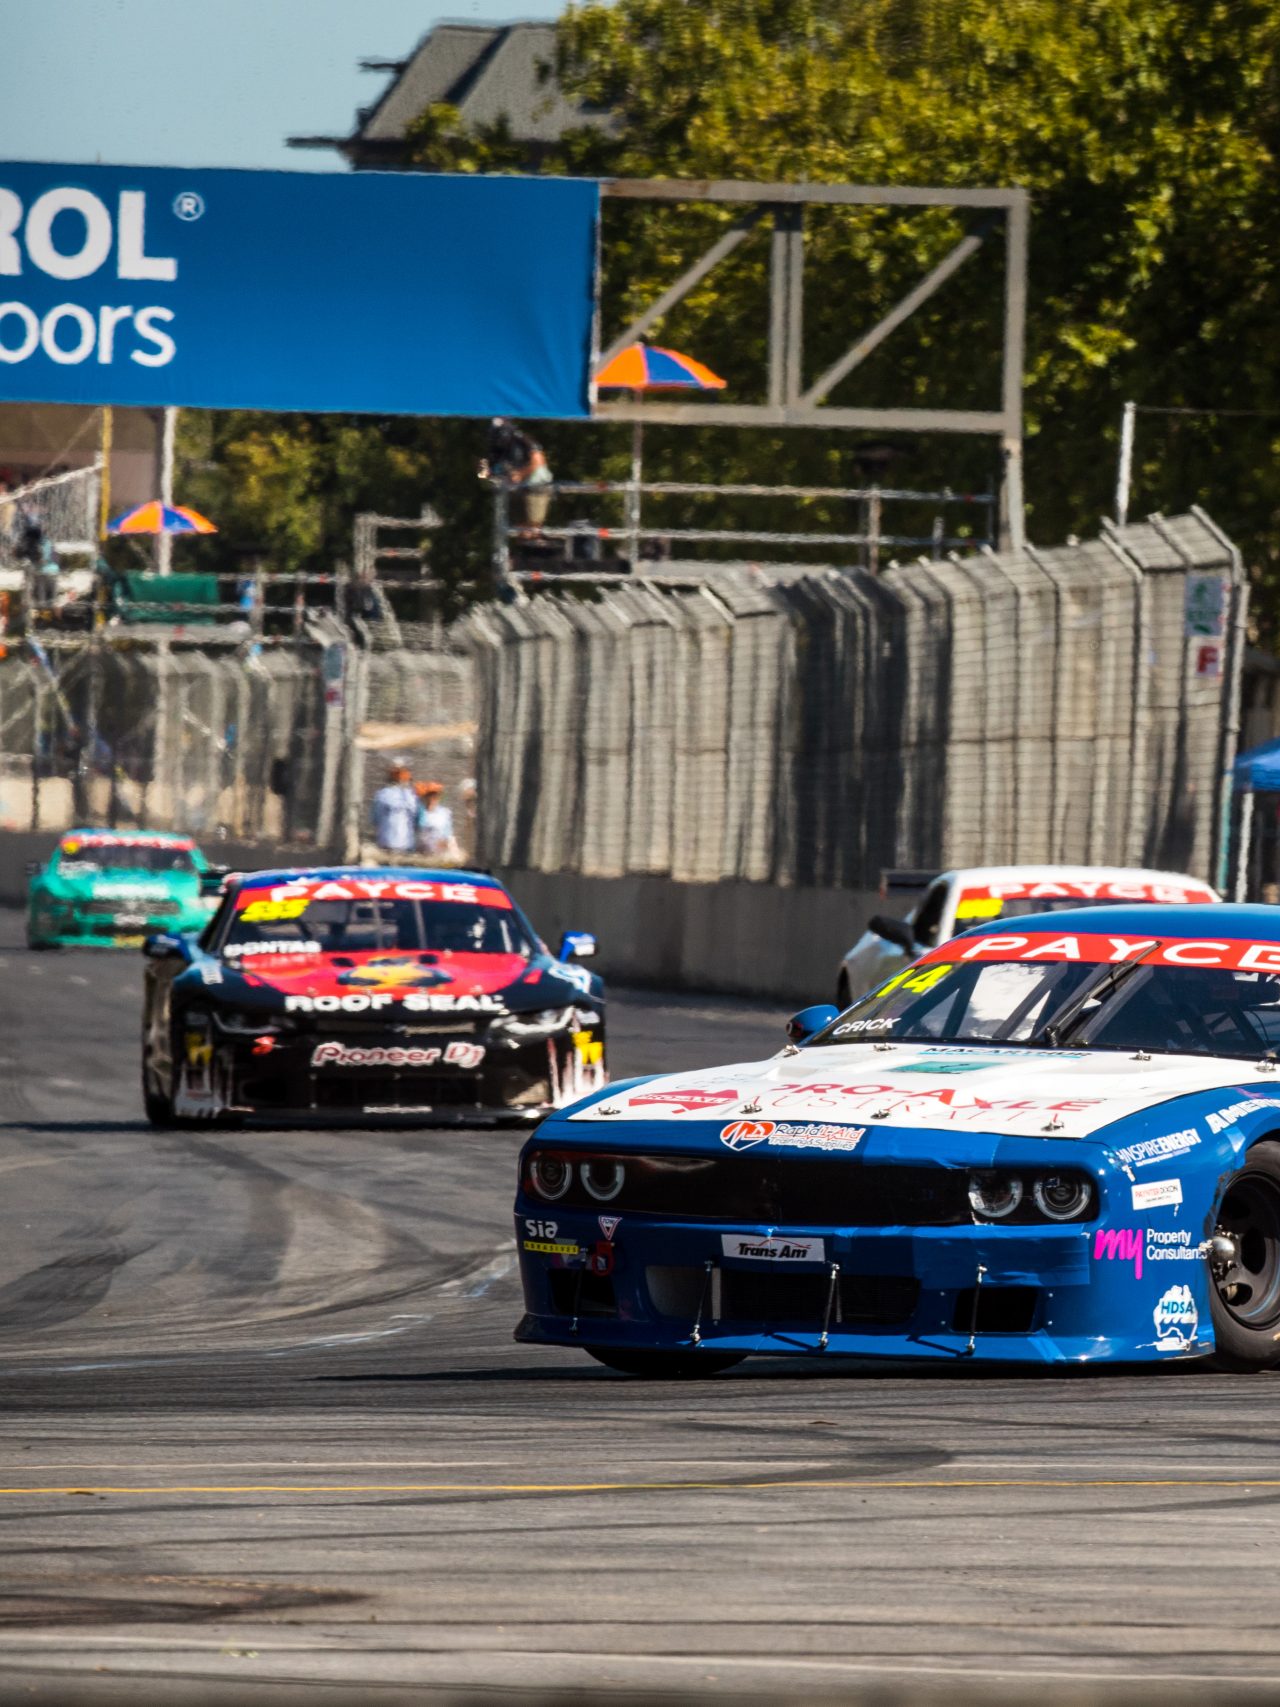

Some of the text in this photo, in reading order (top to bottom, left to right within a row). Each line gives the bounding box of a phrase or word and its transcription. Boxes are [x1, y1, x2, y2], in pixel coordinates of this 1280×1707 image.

[0, 301, 177, 367] oors
[271, 881, 479, 902] PAYCE
[988, 882, 1189, 904] PAYCE
[876, 964, 952, 998] 14
[285, 993, 501, 1012] ROOF SEAL
[833, 1017, 901, 1035] CRICK
[311, 1042, 441, 1067] Pioneer
[775, 1124, 821, 1138] Rapid
[1146, 1228, 1192, 1246] Property
[523, 1241, 579, 1255] ABRASIVES
[738, 1242, 808, 1259] Trans Am
[1094, 1228, 1143, 1280] my
[1161, 1301, 1195, 1315] HDSA
